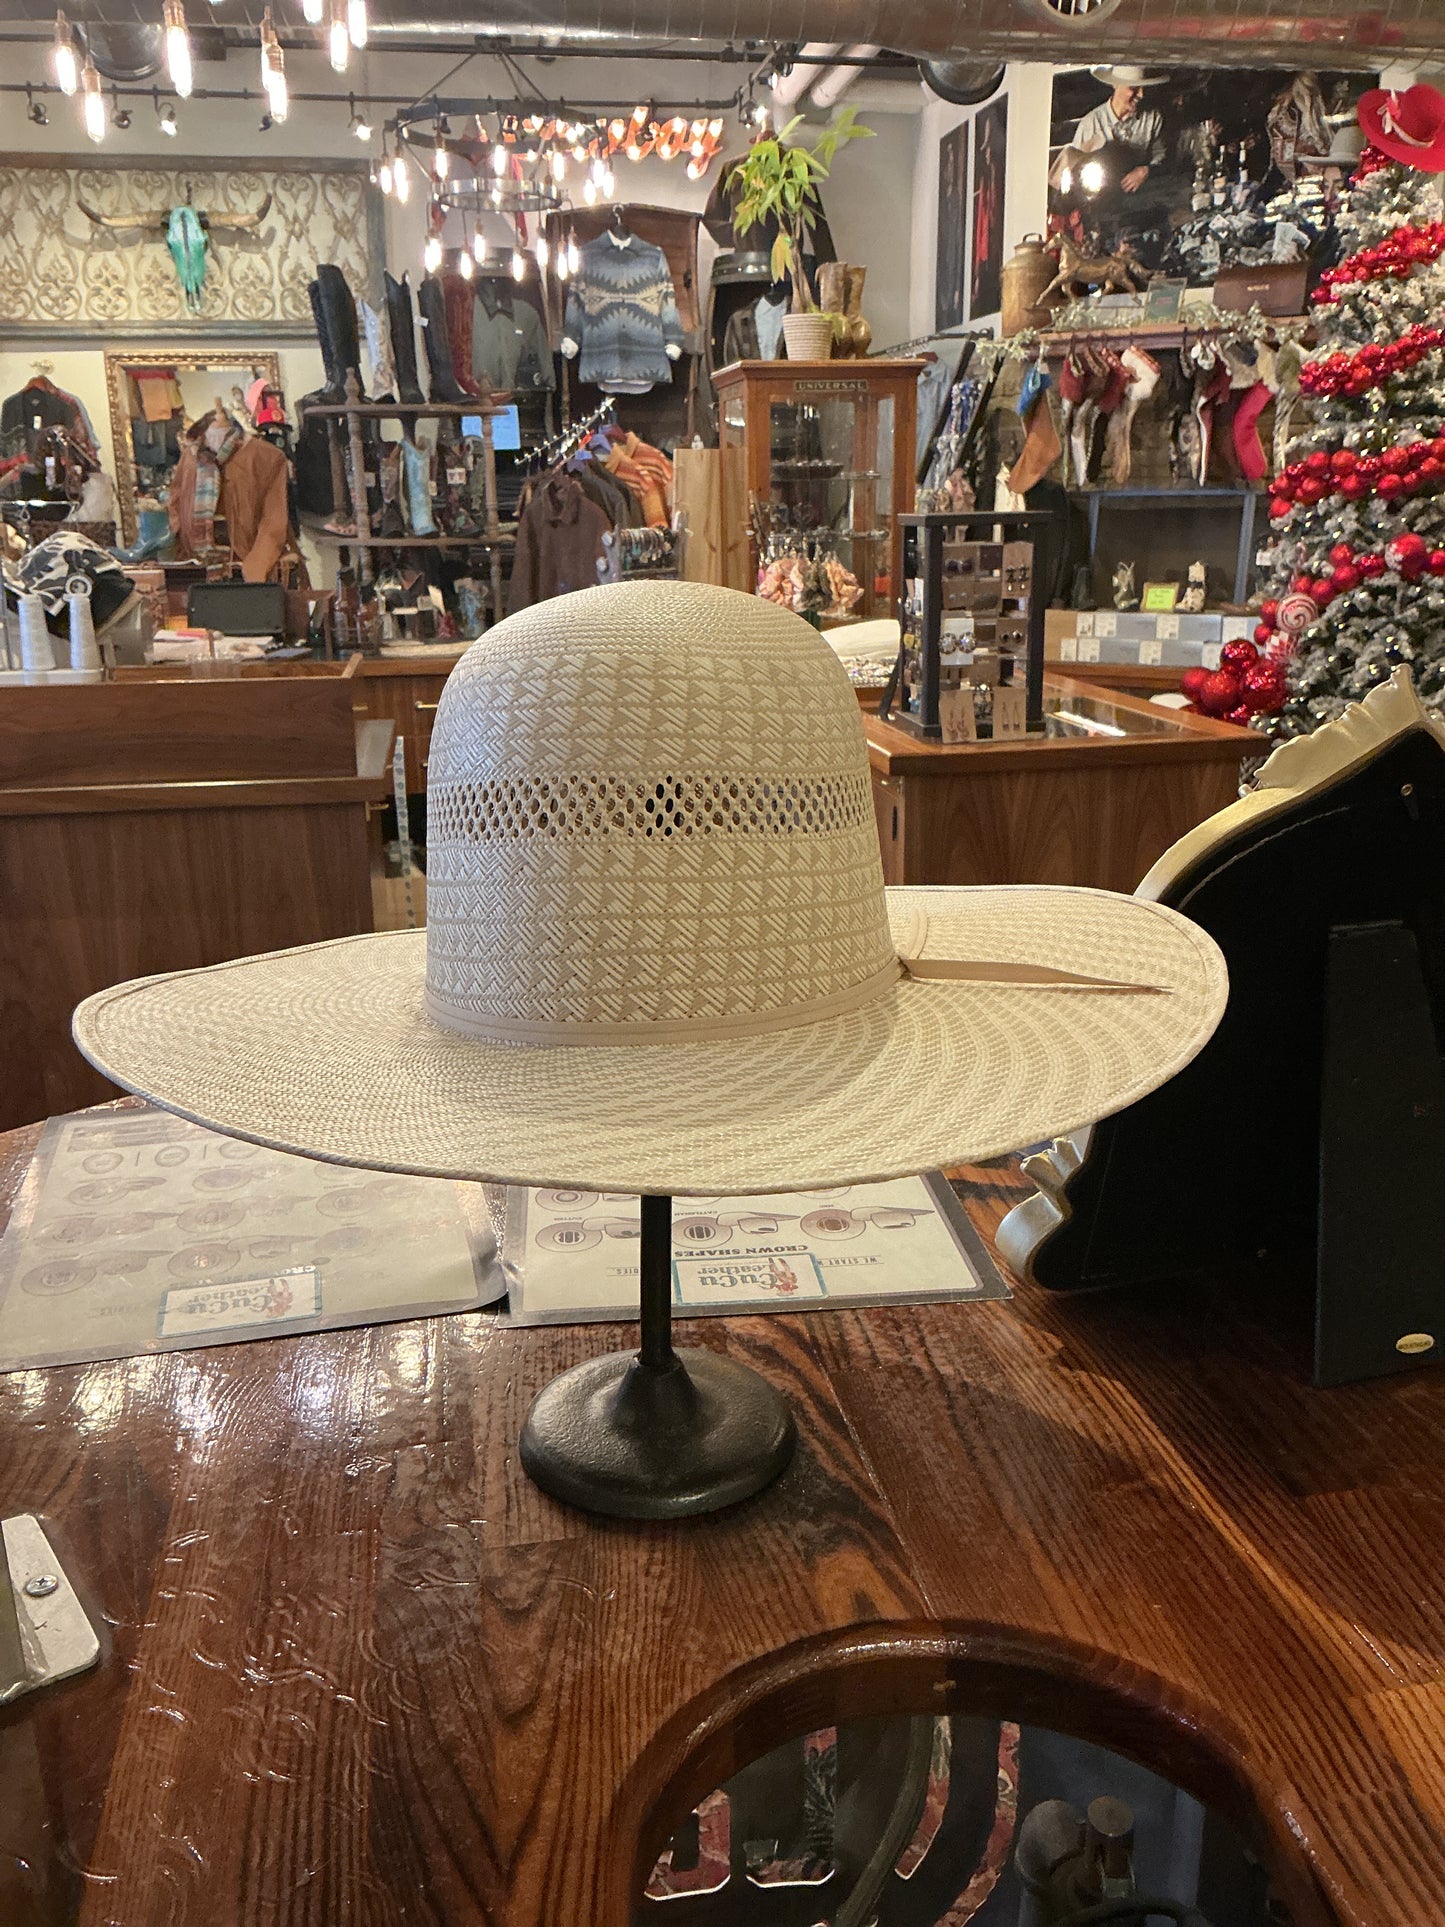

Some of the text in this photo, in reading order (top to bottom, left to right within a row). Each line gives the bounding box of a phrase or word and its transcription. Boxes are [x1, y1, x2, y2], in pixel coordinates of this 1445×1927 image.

[798, 382, 865, 391] UNIVERSAL
[674, 1244, 808, 1258] CROWN SHAPES
[828, 1258, 859, 1266] START
[697, 1264, 771, 1275] Leather
[697, 1273, 778, 1289] CuCu
[188, 1295, 272, 1315] CuCu
